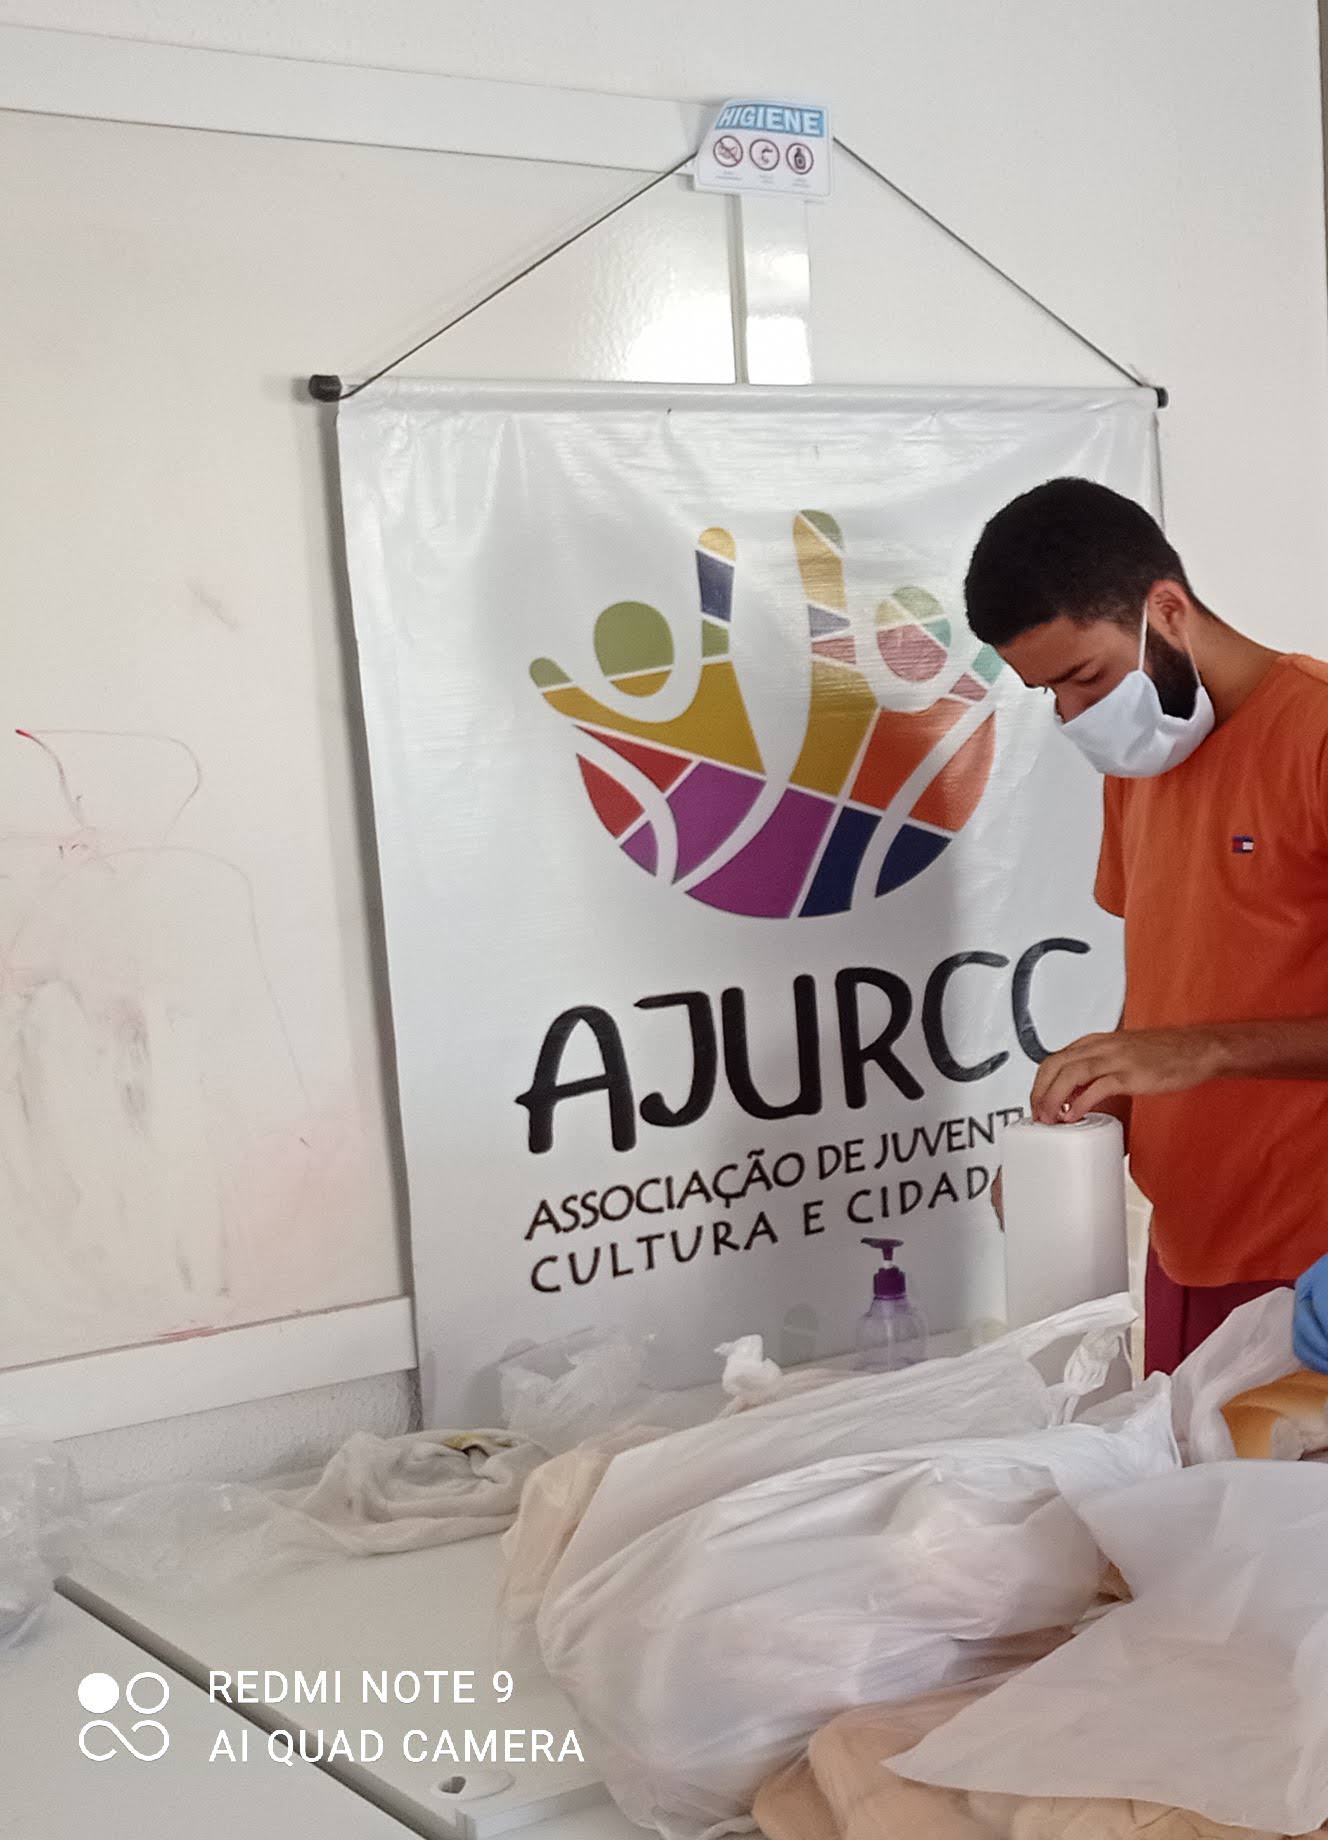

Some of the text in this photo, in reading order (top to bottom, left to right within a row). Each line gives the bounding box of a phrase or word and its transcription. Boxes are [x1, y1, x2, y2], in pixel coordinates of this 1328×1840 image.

[718, 105, 821, 135] HIGIENE
[514, 937, 1091, 1154] AJURCC
[524, 1148, 804, 1240] ASSOCIAÇÃO
[818, 1138, 866, 1181] DE
[531, 1166, 990, 1294] CULTURA E CIDAD
